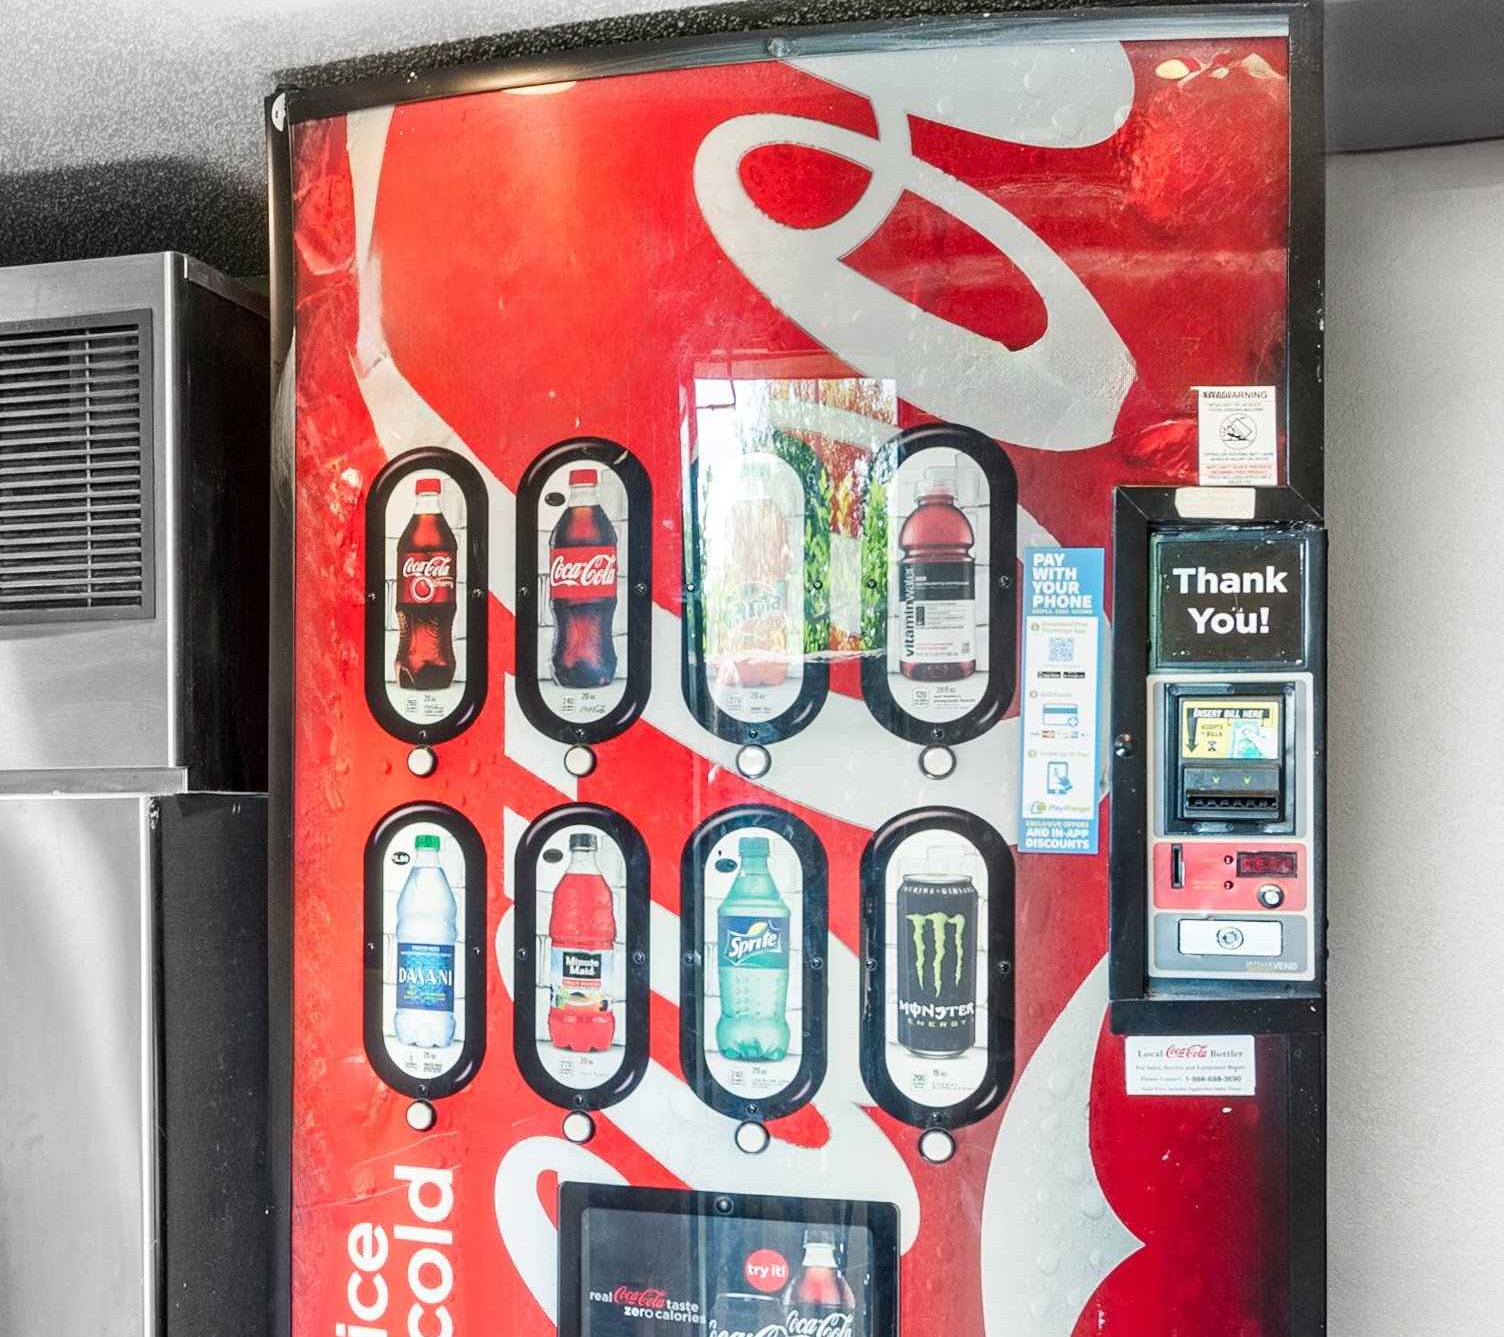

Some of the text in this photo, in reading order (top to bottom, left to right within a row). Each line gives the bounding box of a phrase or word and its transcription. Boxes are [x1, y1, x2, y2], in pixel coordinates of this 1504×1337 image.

[403, 556, 453, 577] Coca-Cola
[1033, 553, 1066, 567] PAY
[550, 553, 617, 587] Coca-Cola
[1033, 567, 1077, 580] WITH
[1172, 565, 1288, 594] Thank
[1033, 581, 1080, 595] YOUR
[1033, 595, 1093, 608] PHONE
[903, 566, 915, 658] vitaminwater
[1187, 606, 1270, 634] You!
[1026, 828, 1089, 839] AND IN-APP
[1025, 838, 1090, 849] DISCOUNTS
[729, 931, 779, 958] Sprite
[565, 955, 600, 967] Minute
[399, 964, 452, 986] DASANI
[569, 965, 596, 976] Maid
[898, 1000, 975, 1020] MONSTER
[907, 1018, 967, 1028] ENERGY
[1138, 1050, 1163, 1058] Local
[1211, 1050, 1243, 1058] Bottler
[747, 1264, 786, 1278] try it!
[589, 1285, 699, 1313] real Coca-Cola taste
[624, 1306, 707, 1325] zero calories
